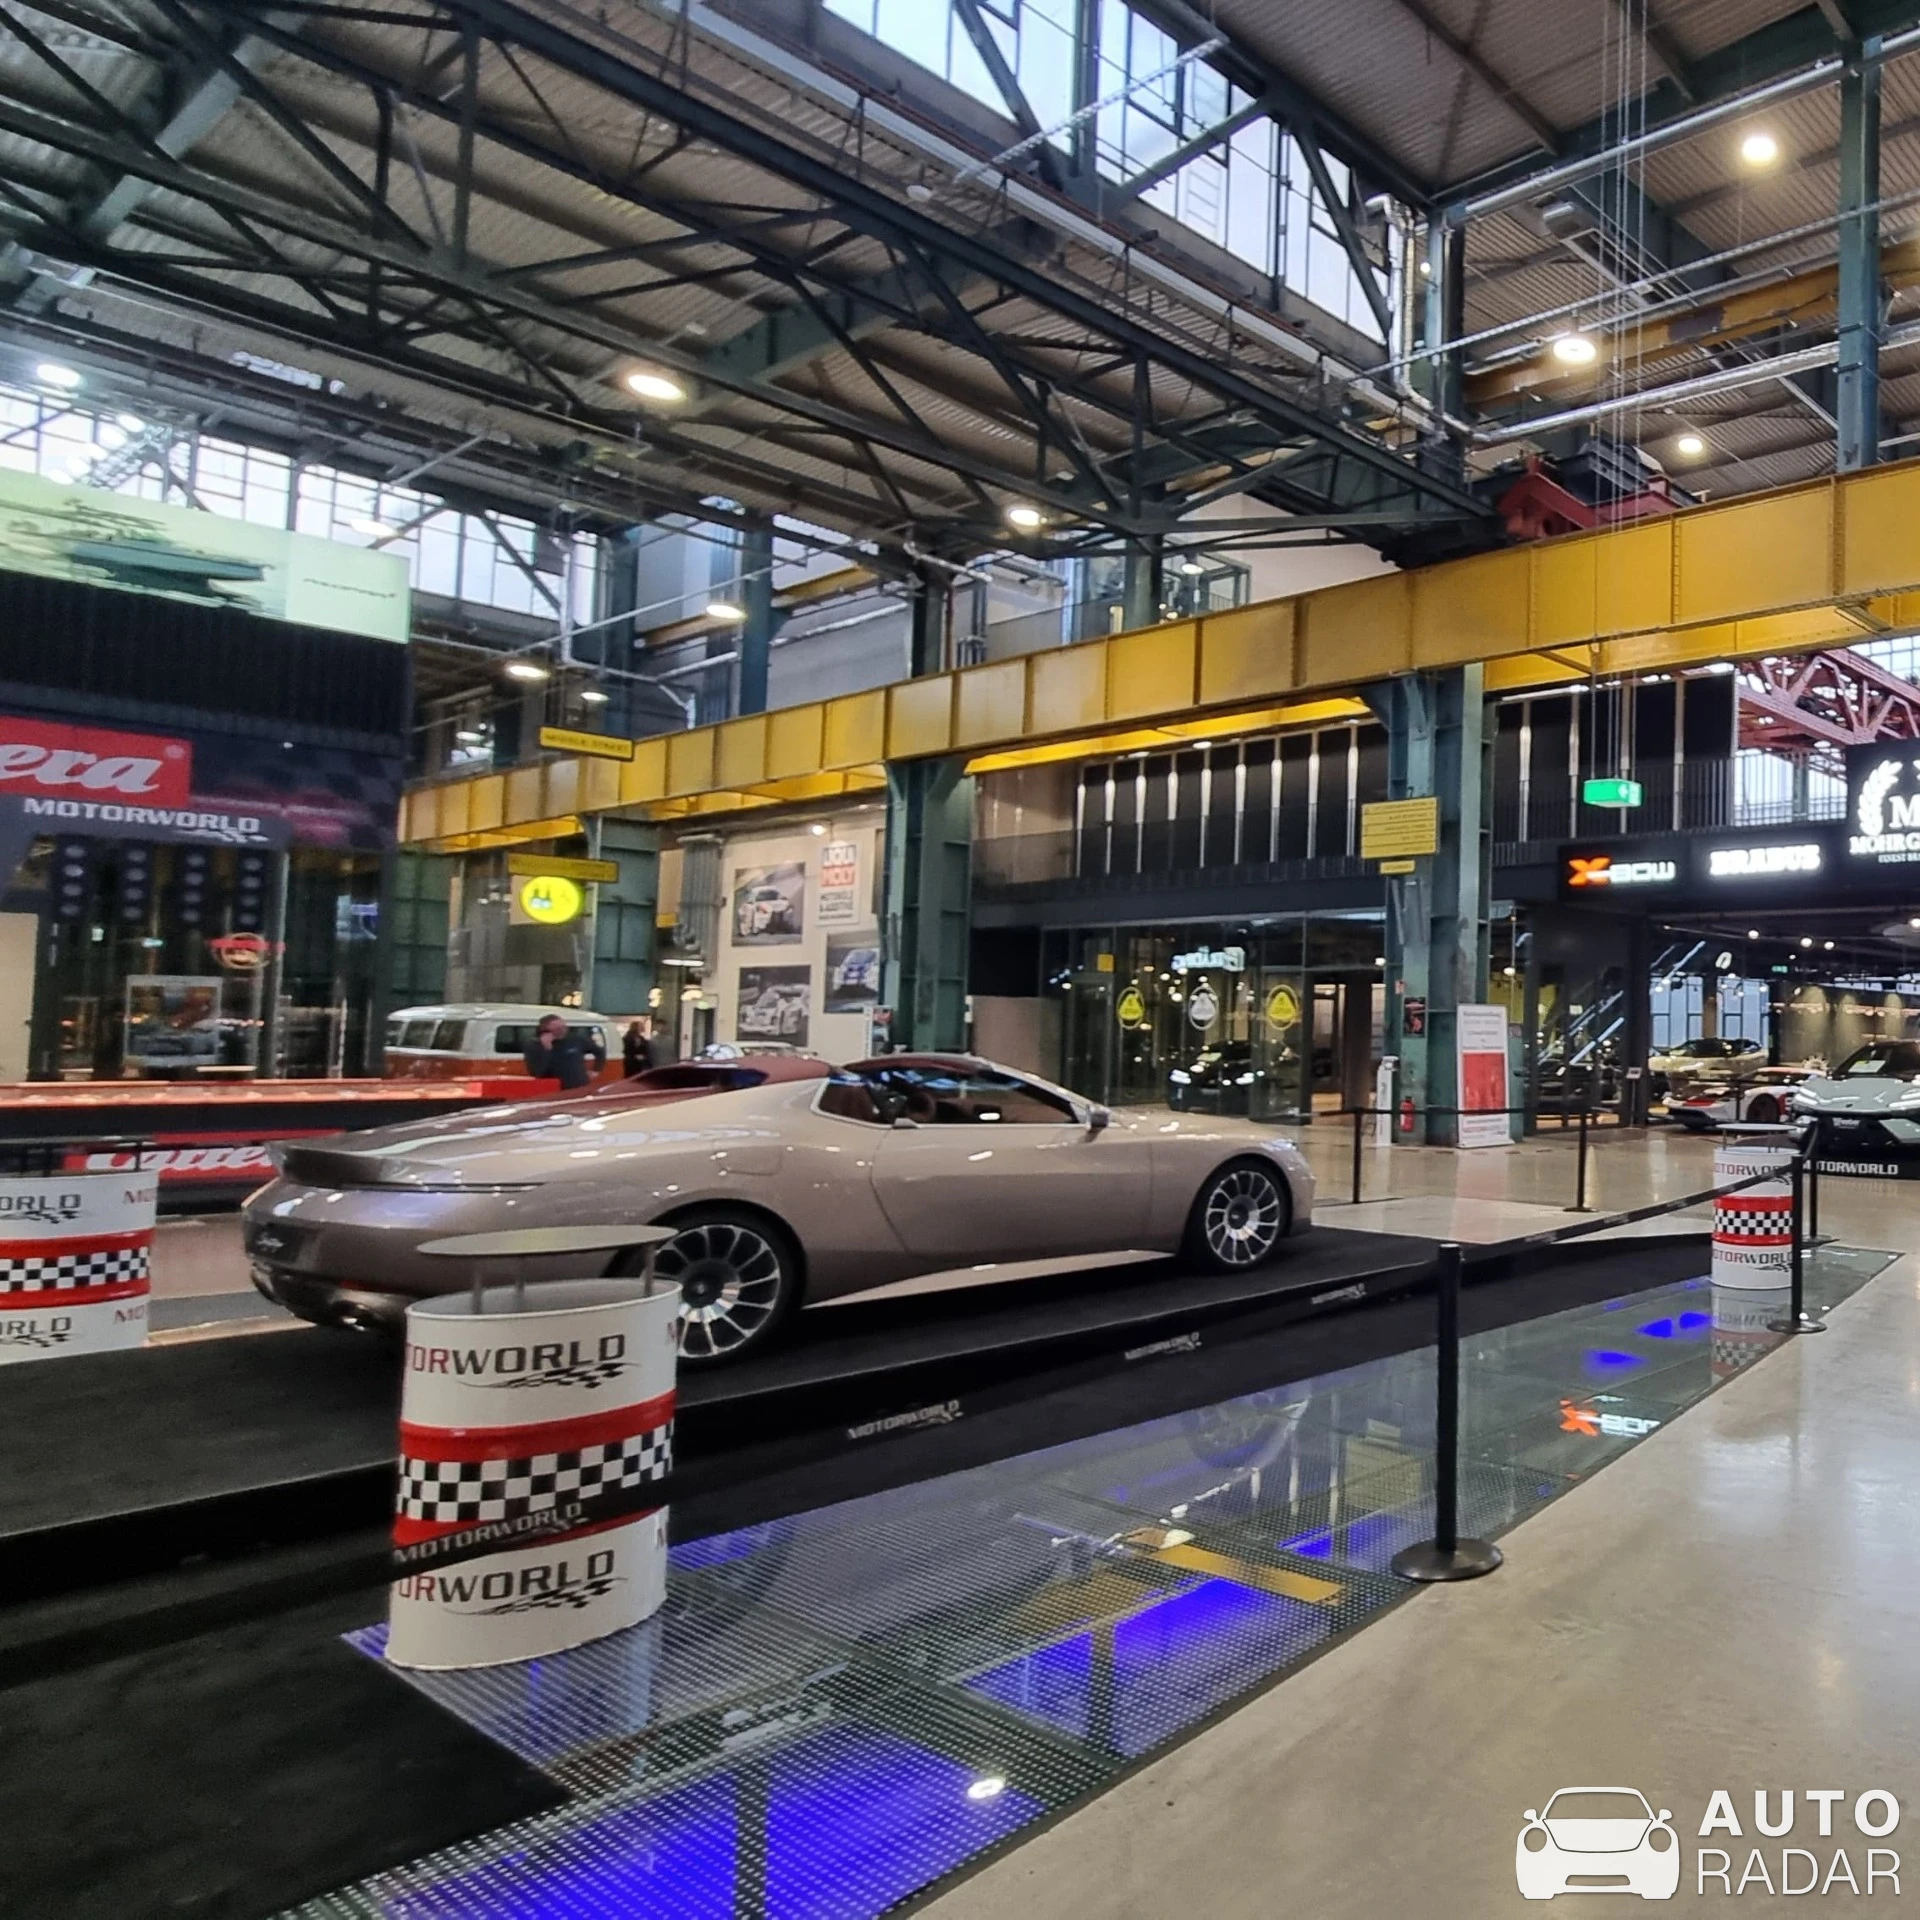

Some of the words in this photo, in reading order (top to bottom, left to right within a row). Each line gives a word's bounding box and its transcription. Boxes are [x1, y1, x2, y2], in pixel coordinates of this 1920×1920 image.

[24, 798, 260, 833] MOTORWORLD
[1567, 856, 1676, 886] X-BOW
[847, 1399, 960, 1439] MOTORWORLD
[394, 1502, 583, 1562] MOTORWORLD
